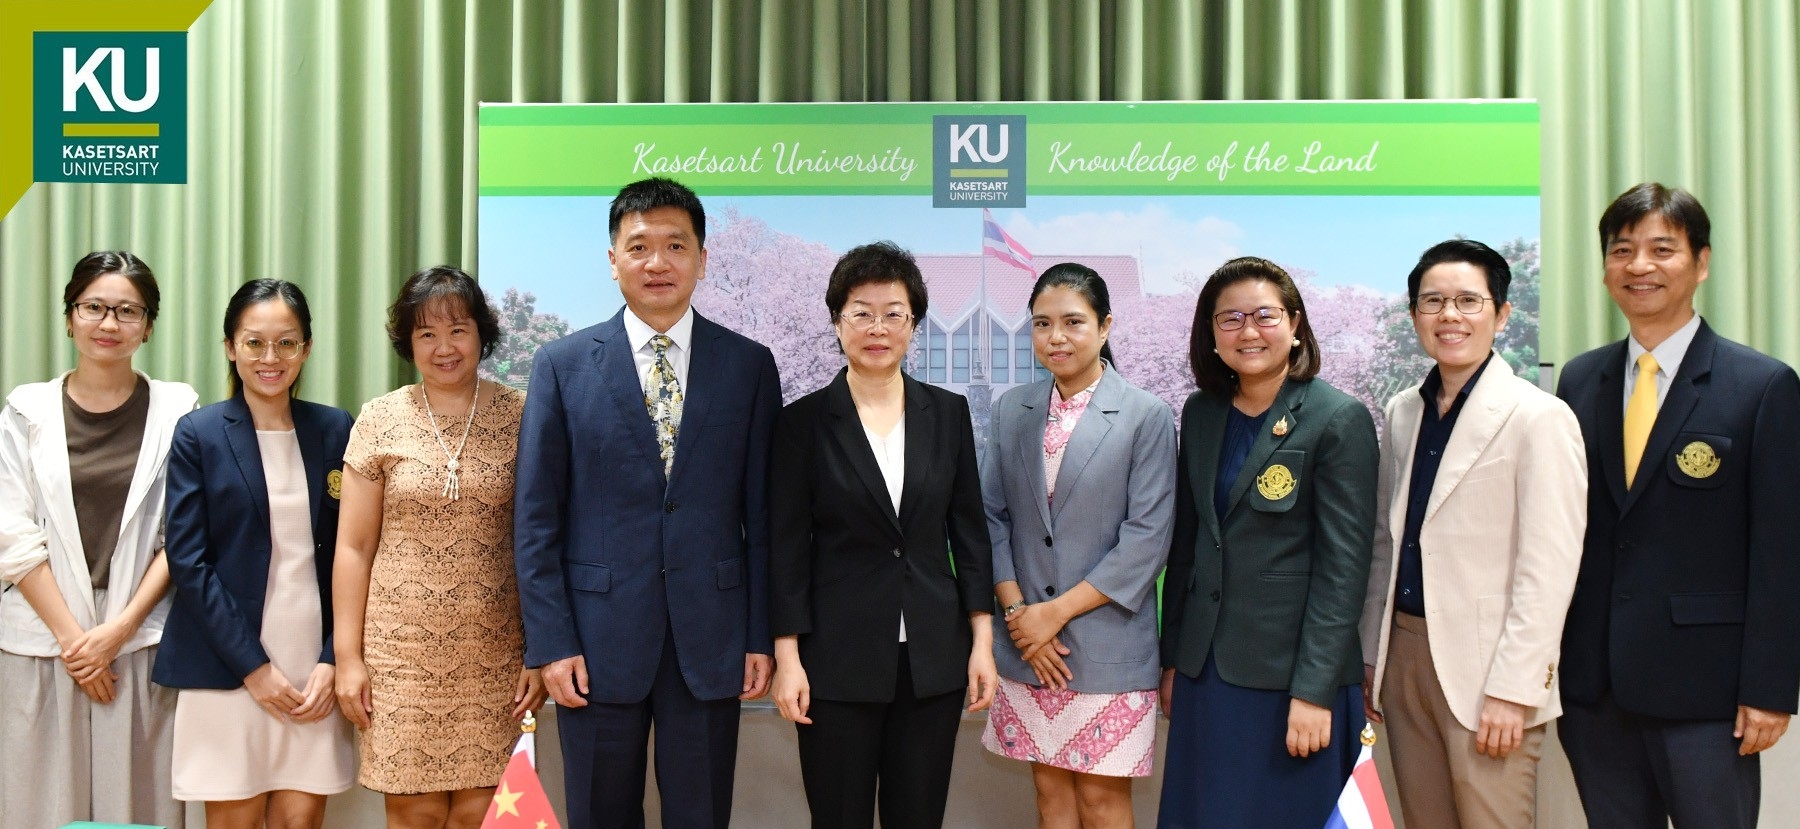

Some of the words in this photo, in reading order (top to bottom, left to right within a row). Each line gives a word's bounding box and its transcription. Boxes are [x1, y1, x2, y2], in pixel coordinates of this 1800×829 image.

[632, 142, 765, 175] Kasetsart
[772, 142, 919, 181] University
[950, 124, 1009, 163] KU
[1048, 141, 1199, 181] Knowledge
[1206, 141, 1237, 181] of
[1243, 141, 1290, 173] the
[1295, 141, 1380, 174] Land
[949, 181, 1009, 191] KASETSART
[949, 191, 1009, 201] UNIVERSITY
